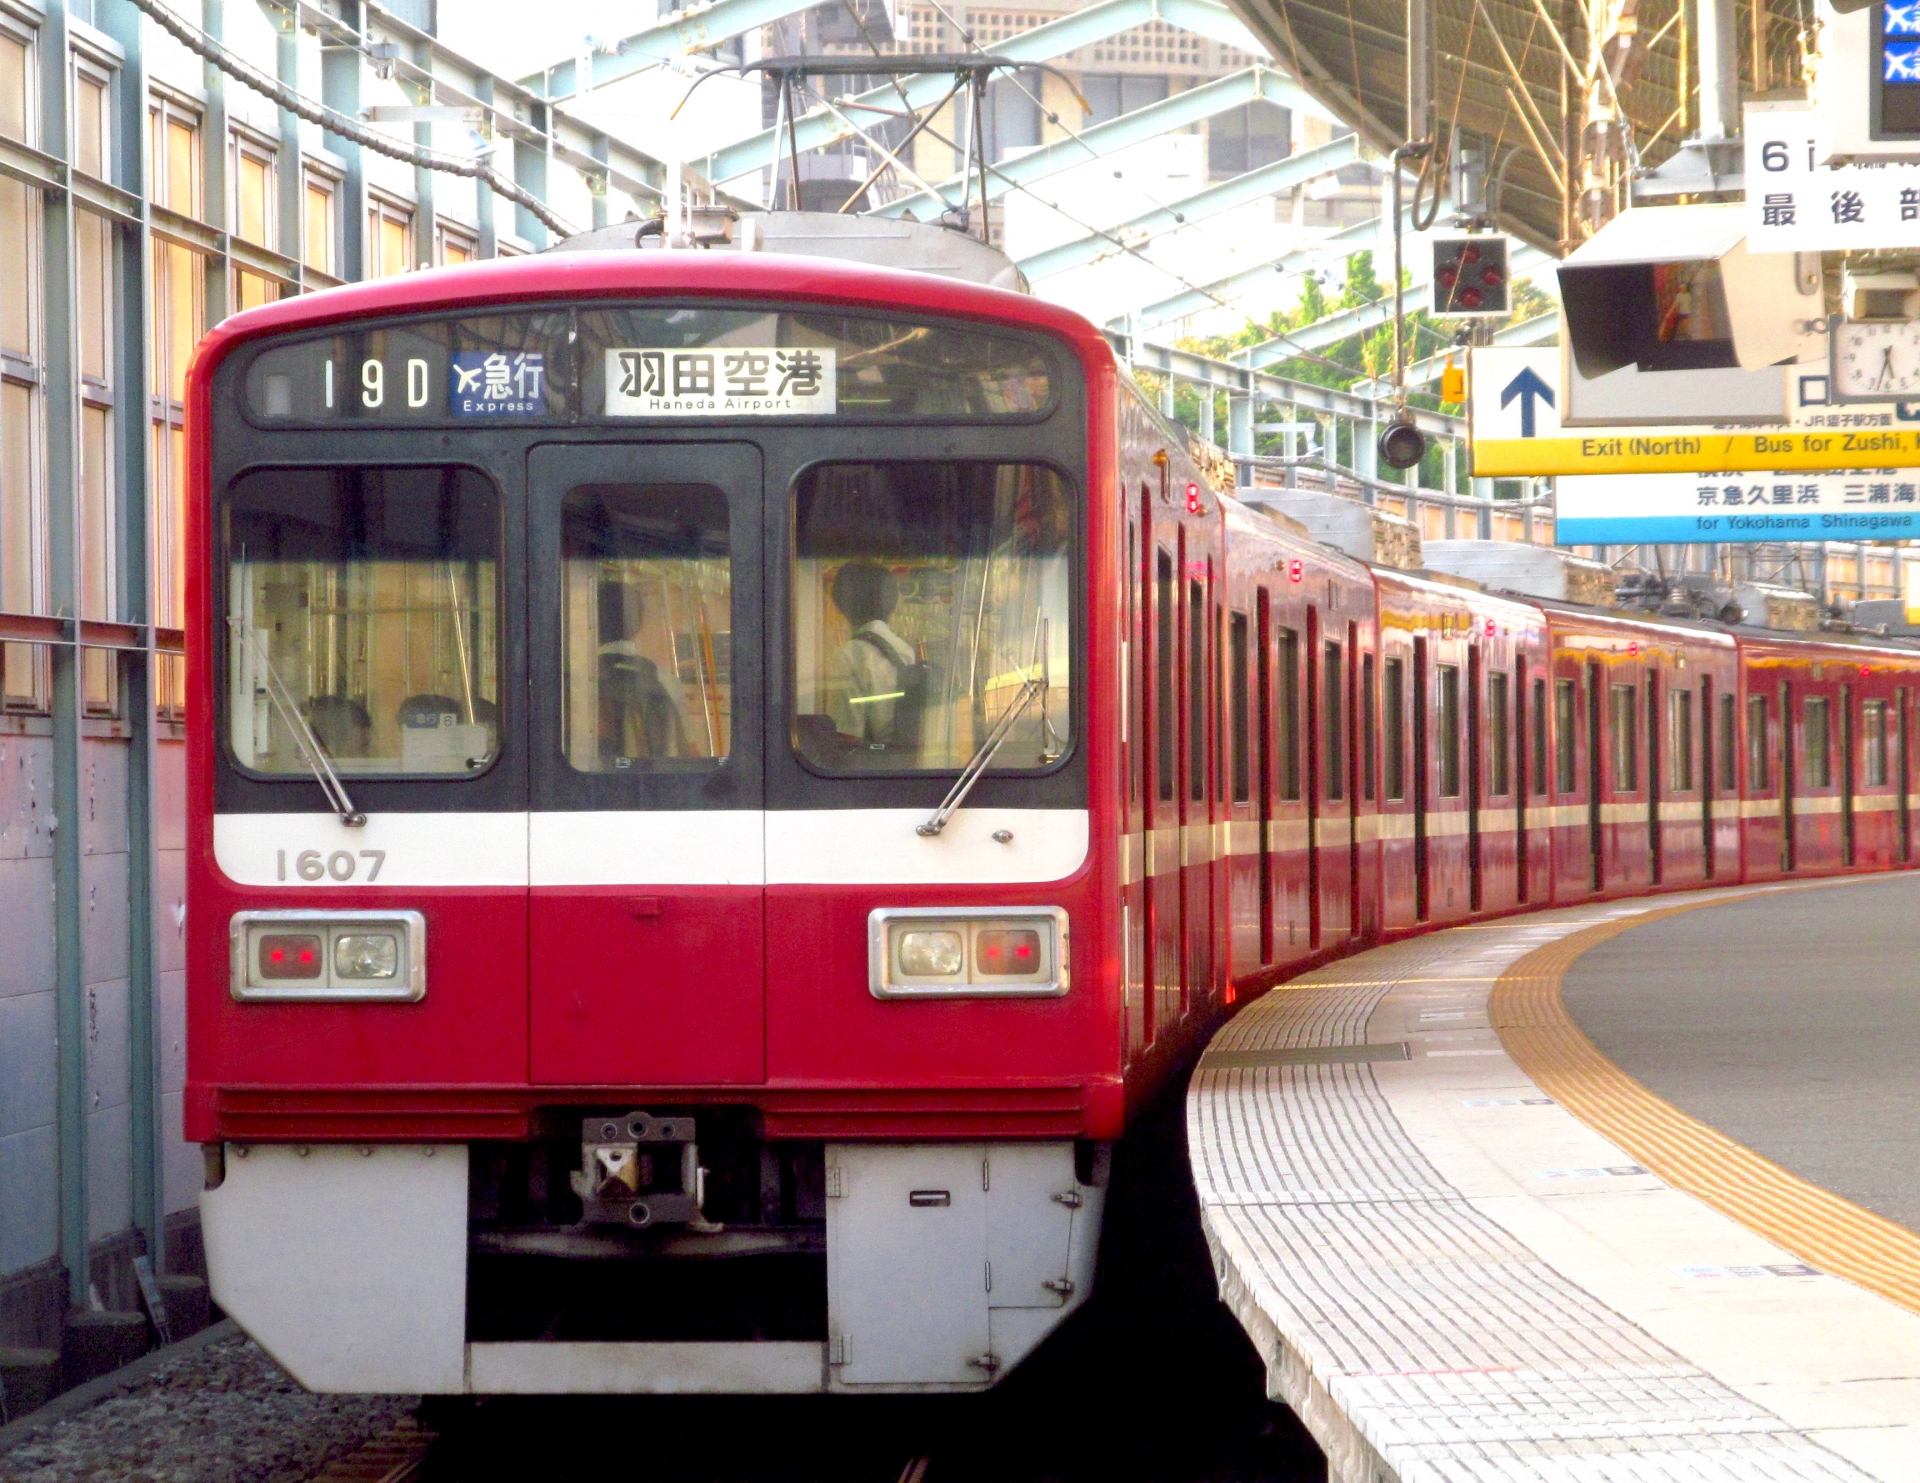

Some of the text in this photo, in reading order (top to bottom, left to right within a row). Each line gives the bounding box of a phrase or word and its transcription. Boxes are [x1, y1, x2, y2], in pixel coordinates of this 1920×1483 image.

[483, 352, 544, 400] 急行
[618, 350, 823, 397] 羽田空港
[463, 400, 534, 413] Express
[649, 397, 792, 410] Haneda Airport
[1582, 438, 1623, 456] Exit
[1629, 436, 1702, 456] (North)
[1754, 436, 1793, 453] Bus
[1803, 434, 1832, 452] for
[1842, 432, 1908, 454] Zushi,
[1696, 482, 1920, 506] 京急久里浜 三浦海
[1696, 513, 1913, 530] for Yokohama Shinagawa
[276, 849, 387, 882] 1607
